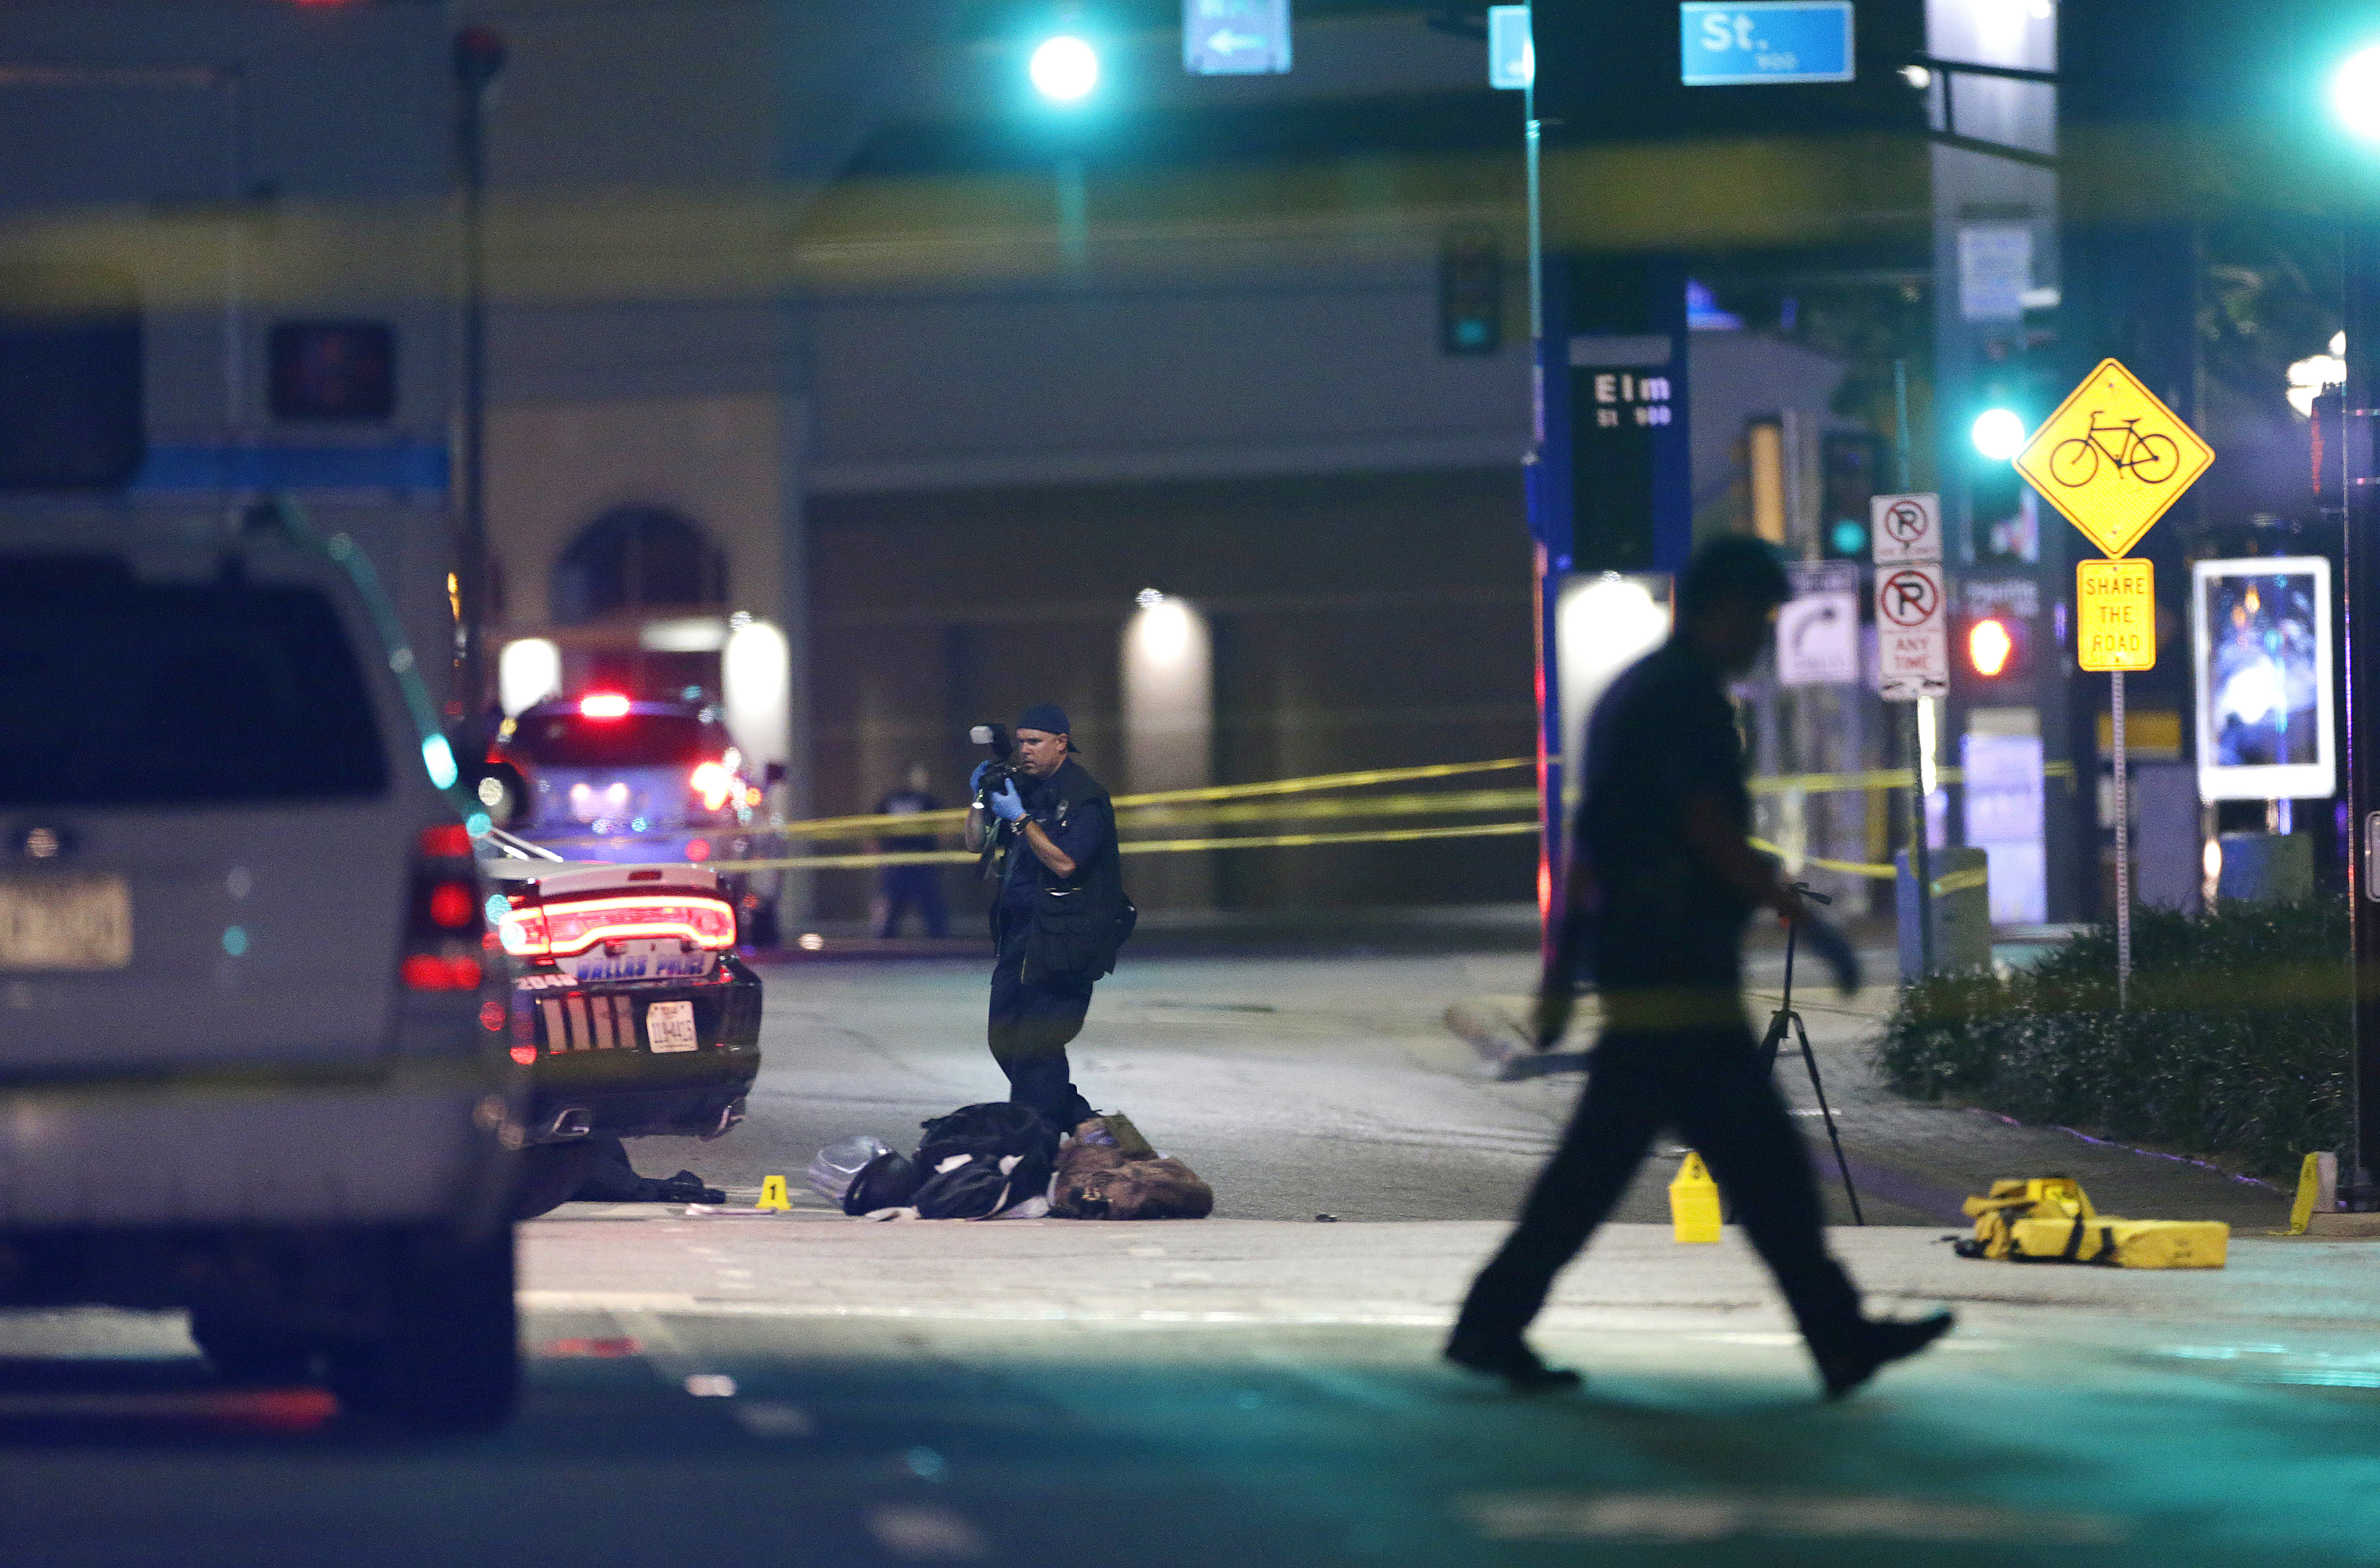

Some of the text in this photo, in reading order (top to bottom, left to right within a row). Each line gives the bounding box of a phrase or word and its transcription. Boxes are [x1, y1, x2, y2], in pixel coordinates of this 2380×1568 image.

[1701, 13, 1768, 52] St.
[1594, 374, 1671, 403] Elm
[2086, 578, 2145, 595] SHARE
[1899, 582, 1924, 616] P
[2099, 606, 2133, 623] THE
[1896, 638, 1929, 650] ANY
[2093, 634, 2139, 652] ROAD
[577, 957, 648, 980] DALLAS
[770, 1183, 777, 1201] 1
